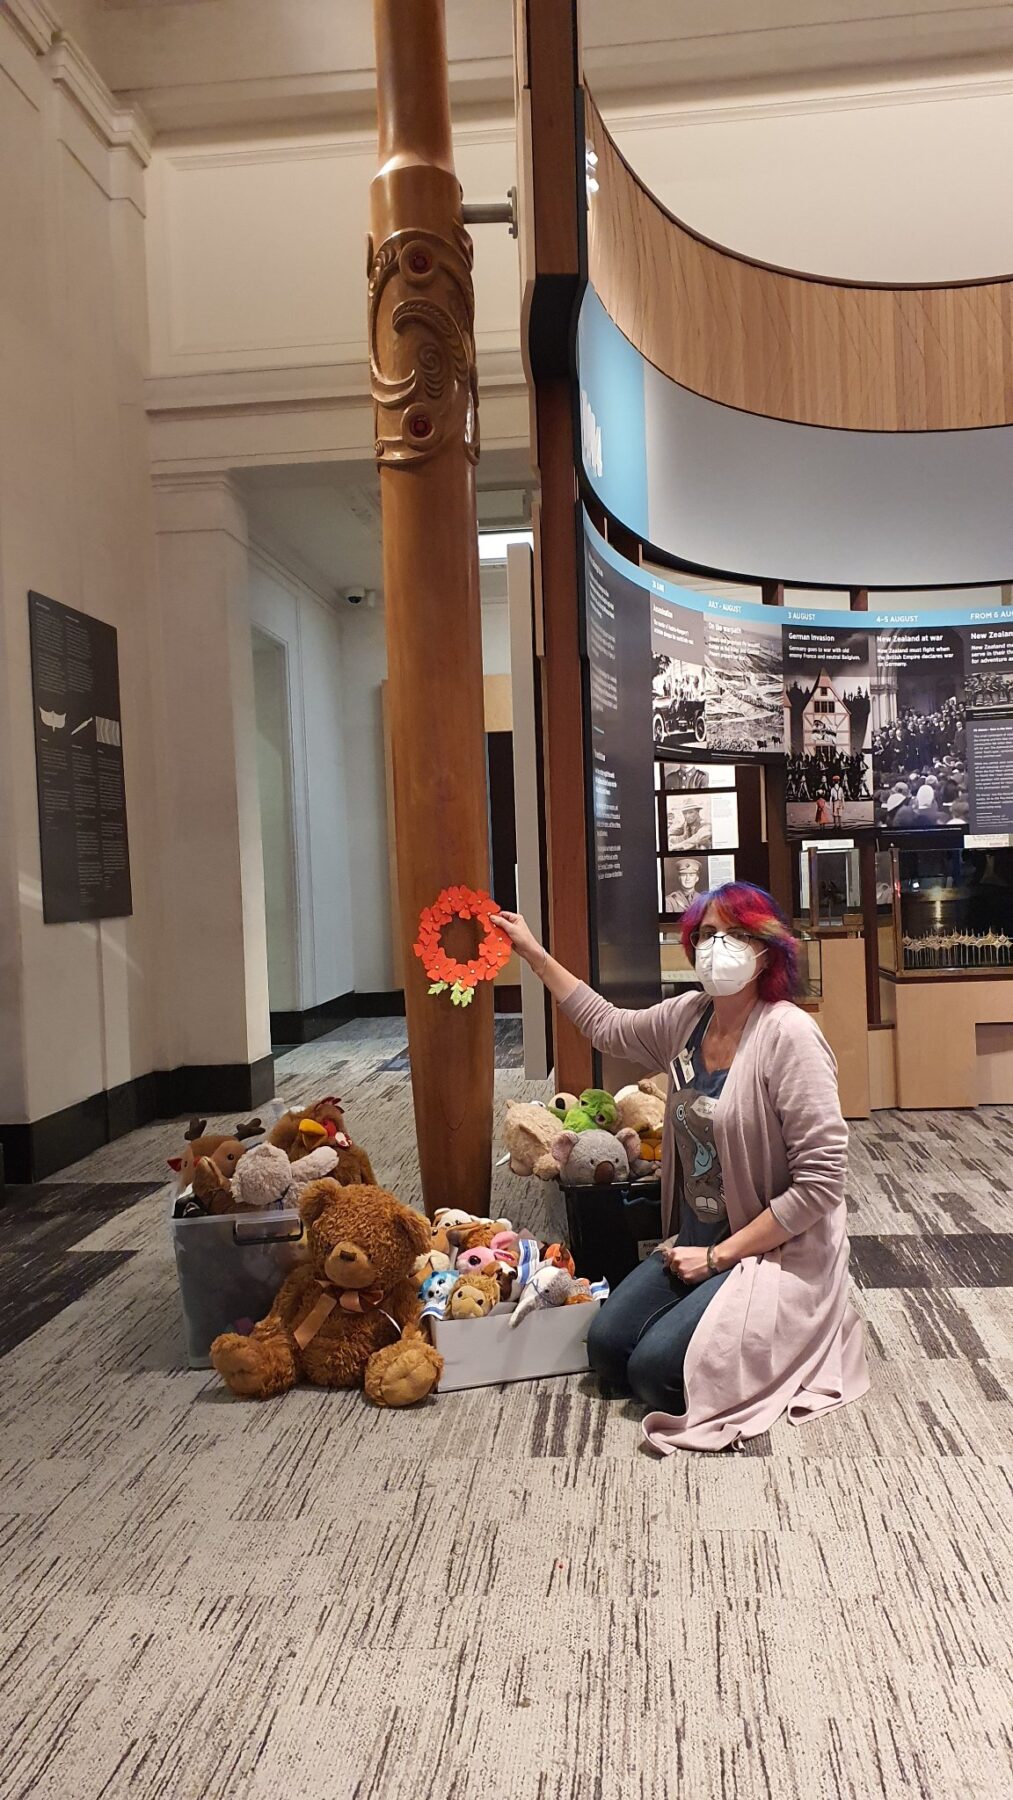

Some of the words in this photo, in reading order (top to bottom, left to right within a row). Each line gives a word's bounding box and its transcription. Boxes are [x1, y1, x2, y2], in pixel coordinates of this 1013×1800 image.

[792, 612, 816, 620] AUGUST
[890, 615, 918, 623] AUGUST
[970, 612, 992, 620] FROM
[788, 632, 811, 641] German
[811, 633, 835, 642] Invasion
[892, 634, 920, 642] Zealand
[921, 634, 929, 642] at
[970, 632, 988, 640] New
[788, 645, 807, 653] Germany
